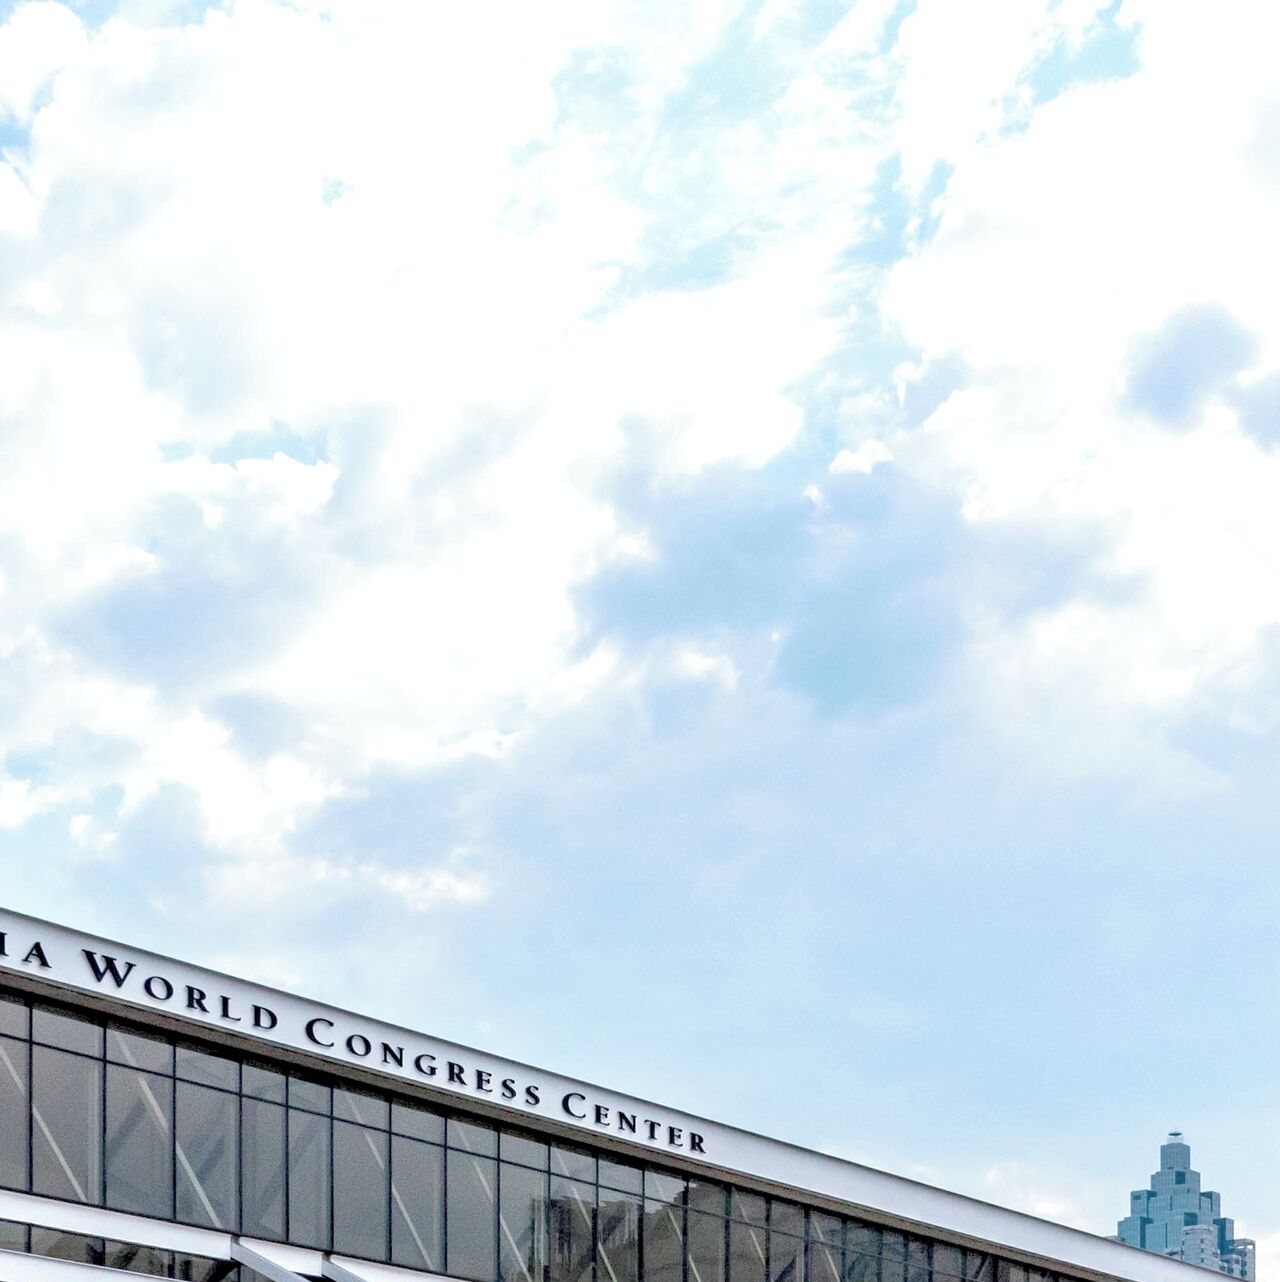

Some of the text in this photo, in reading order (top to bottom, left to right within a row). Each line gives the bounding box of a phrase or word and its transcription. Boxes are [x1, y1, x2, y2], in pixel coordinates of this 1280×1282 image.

[81, 949, 278, 1030] WORLD
[305, 1018, 540, 1106] CONGRESS
[561, 1093, 706, 1153] CENTER
